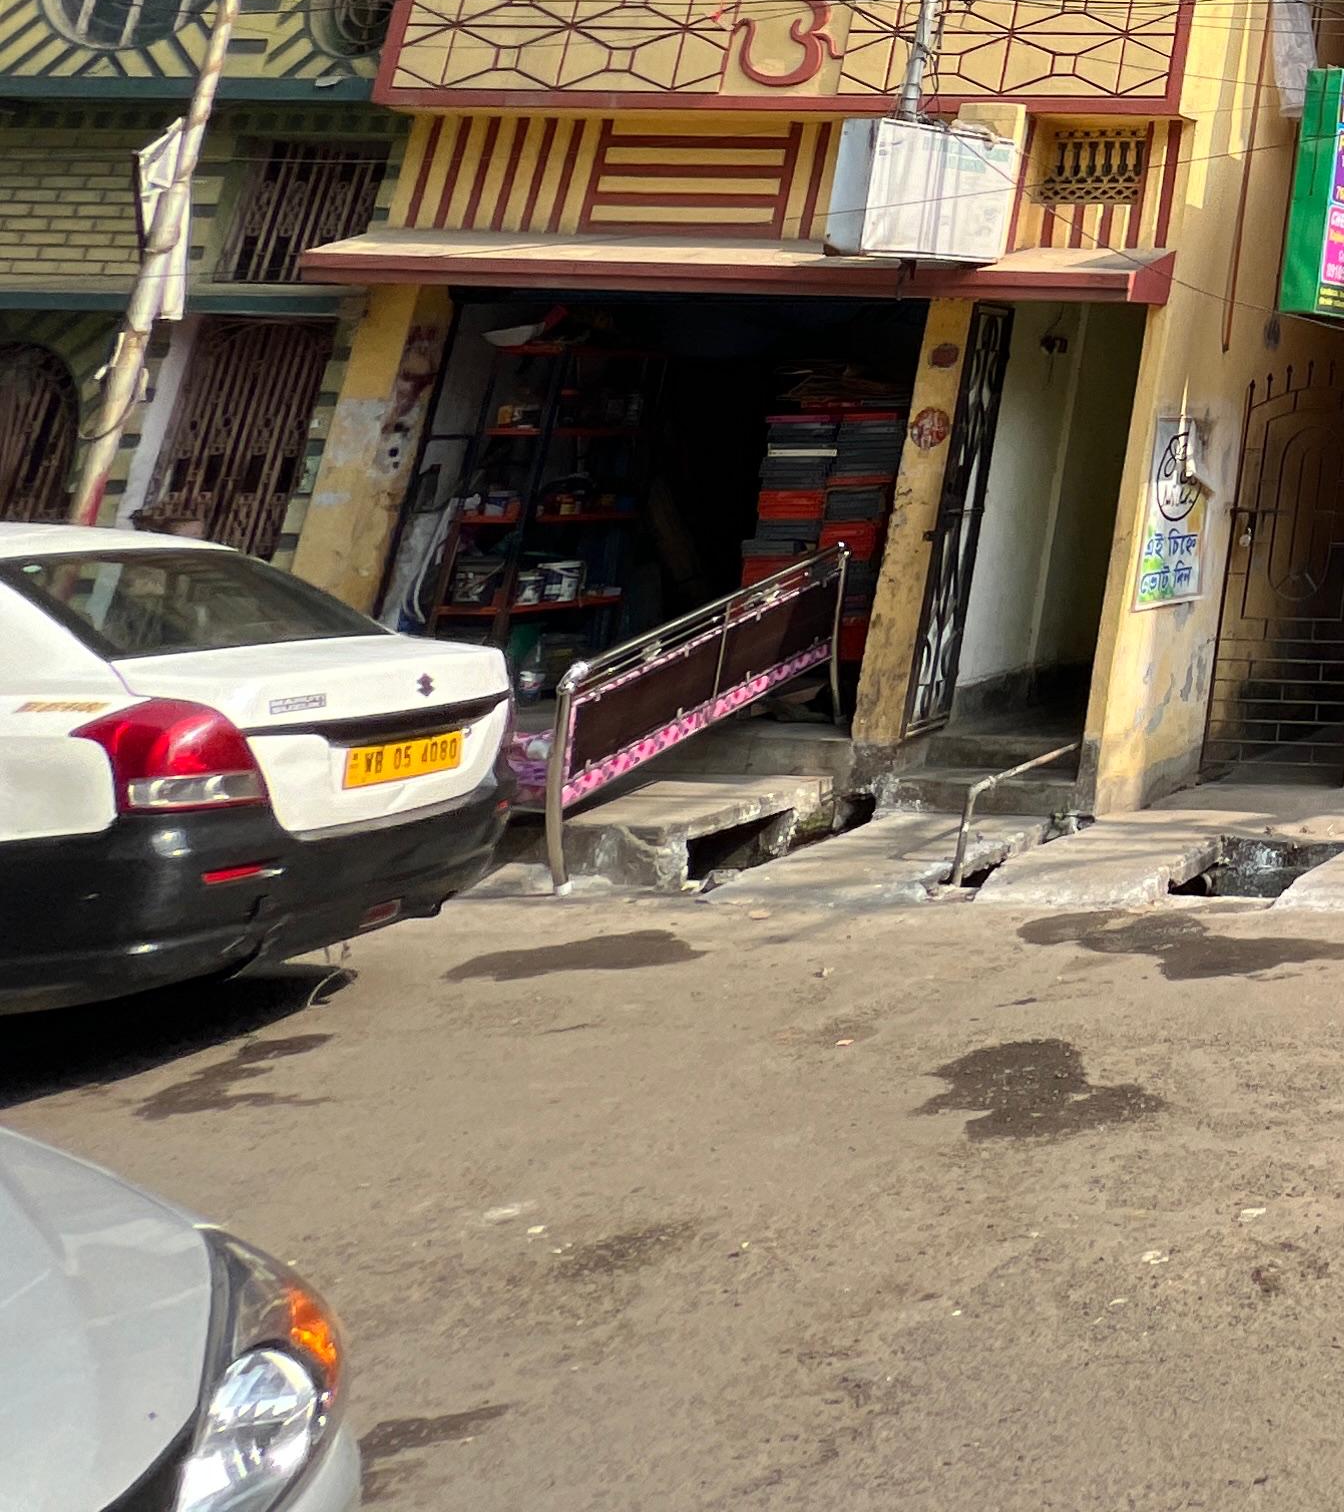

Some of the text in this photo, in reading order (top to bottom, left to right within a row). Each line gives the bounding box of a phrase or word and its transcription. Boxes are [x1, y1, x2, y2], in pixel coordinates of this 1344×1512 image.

[1145, 528, 1198, 559] এই চিহ্নে
[1140, 560, 1193, 594] ভোট দিন
[365, 738, 457, 773] WB 05 4080
